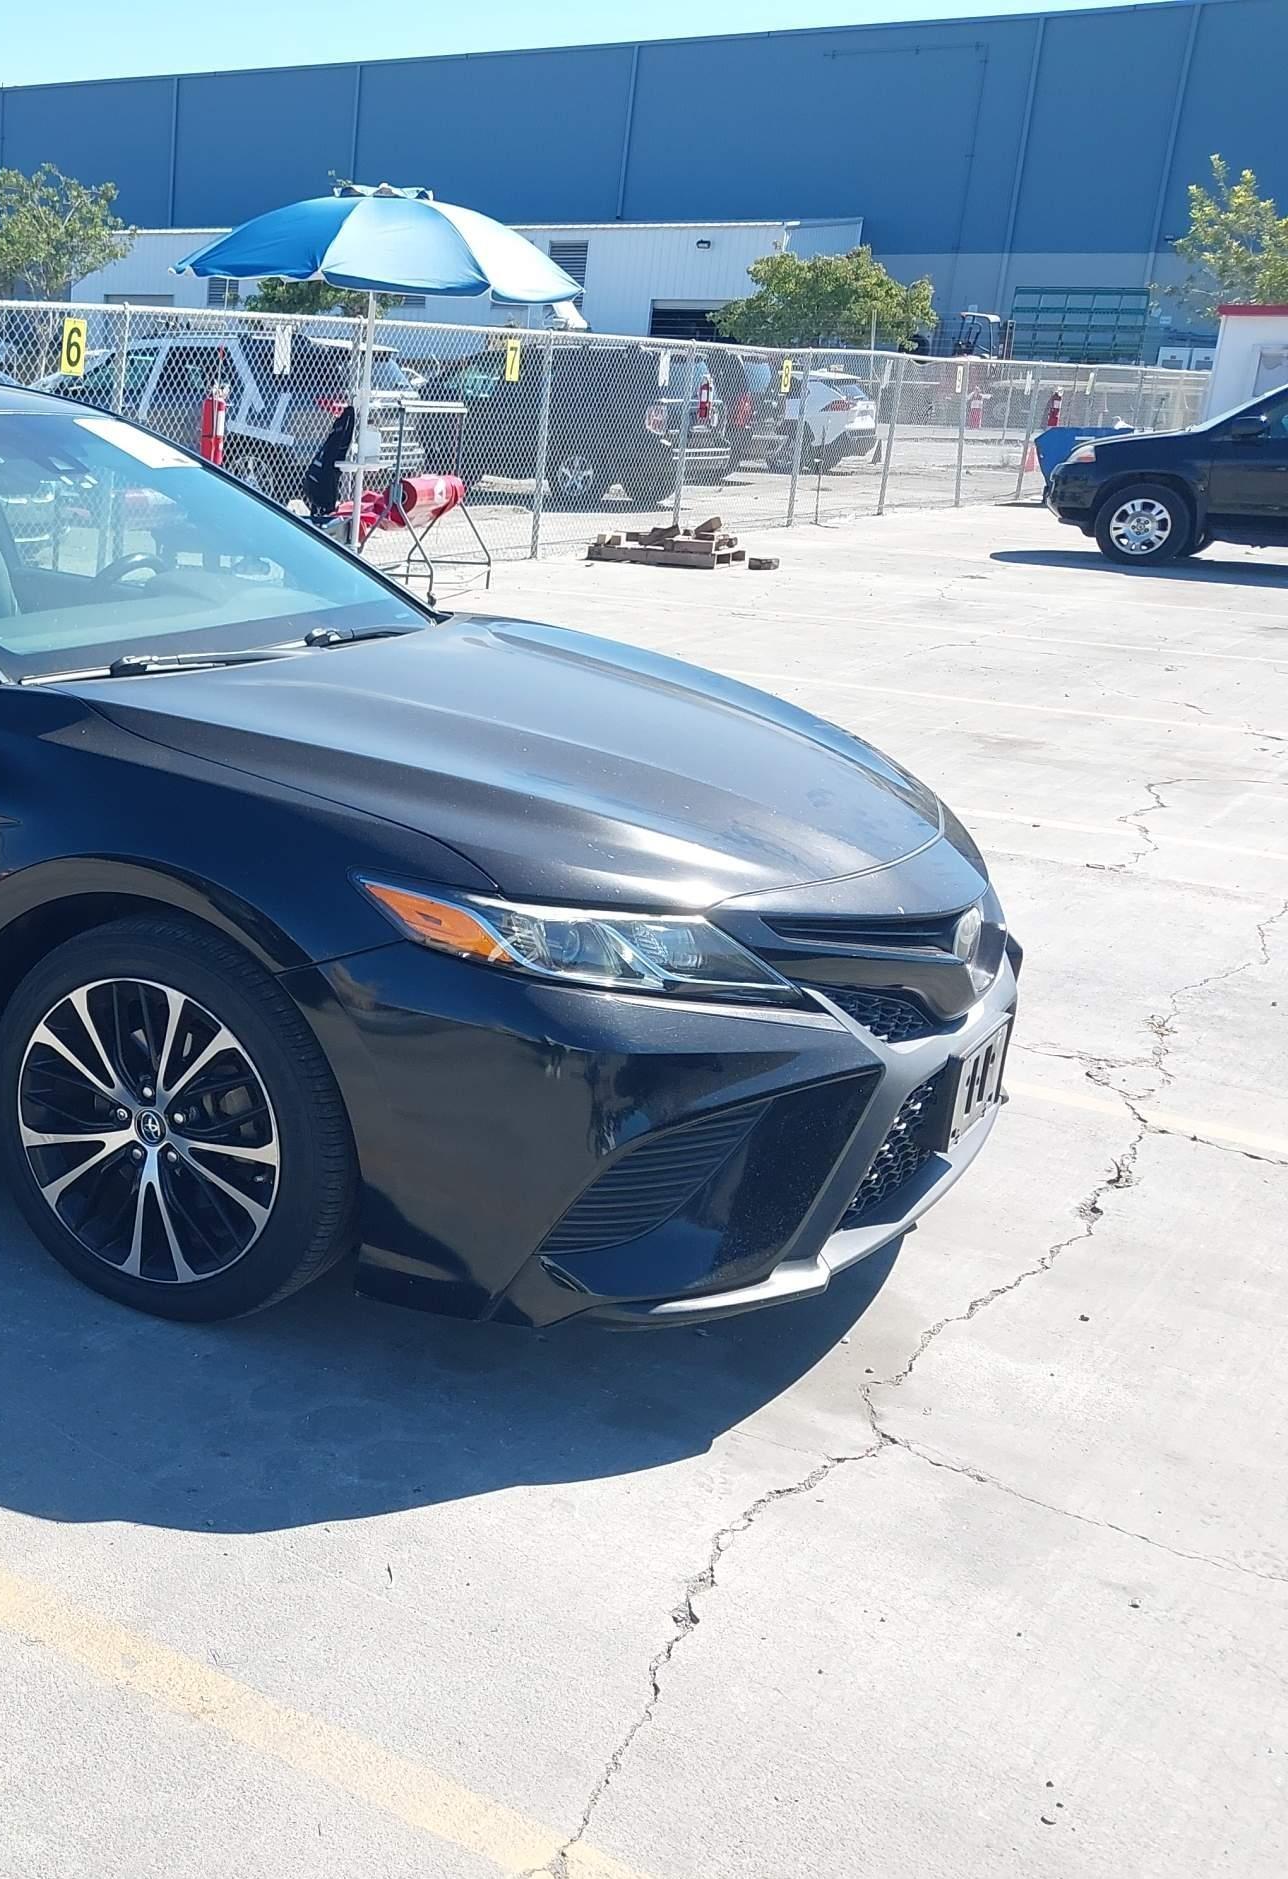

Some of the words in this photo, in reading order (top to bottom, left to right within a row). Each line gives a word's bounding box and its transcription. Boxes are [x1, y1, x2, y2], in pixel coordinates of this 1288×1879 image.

[66, 326, 82, 368] 6
[509, 346, 519, 376] 7
[783, 364, 790, 388] 8
